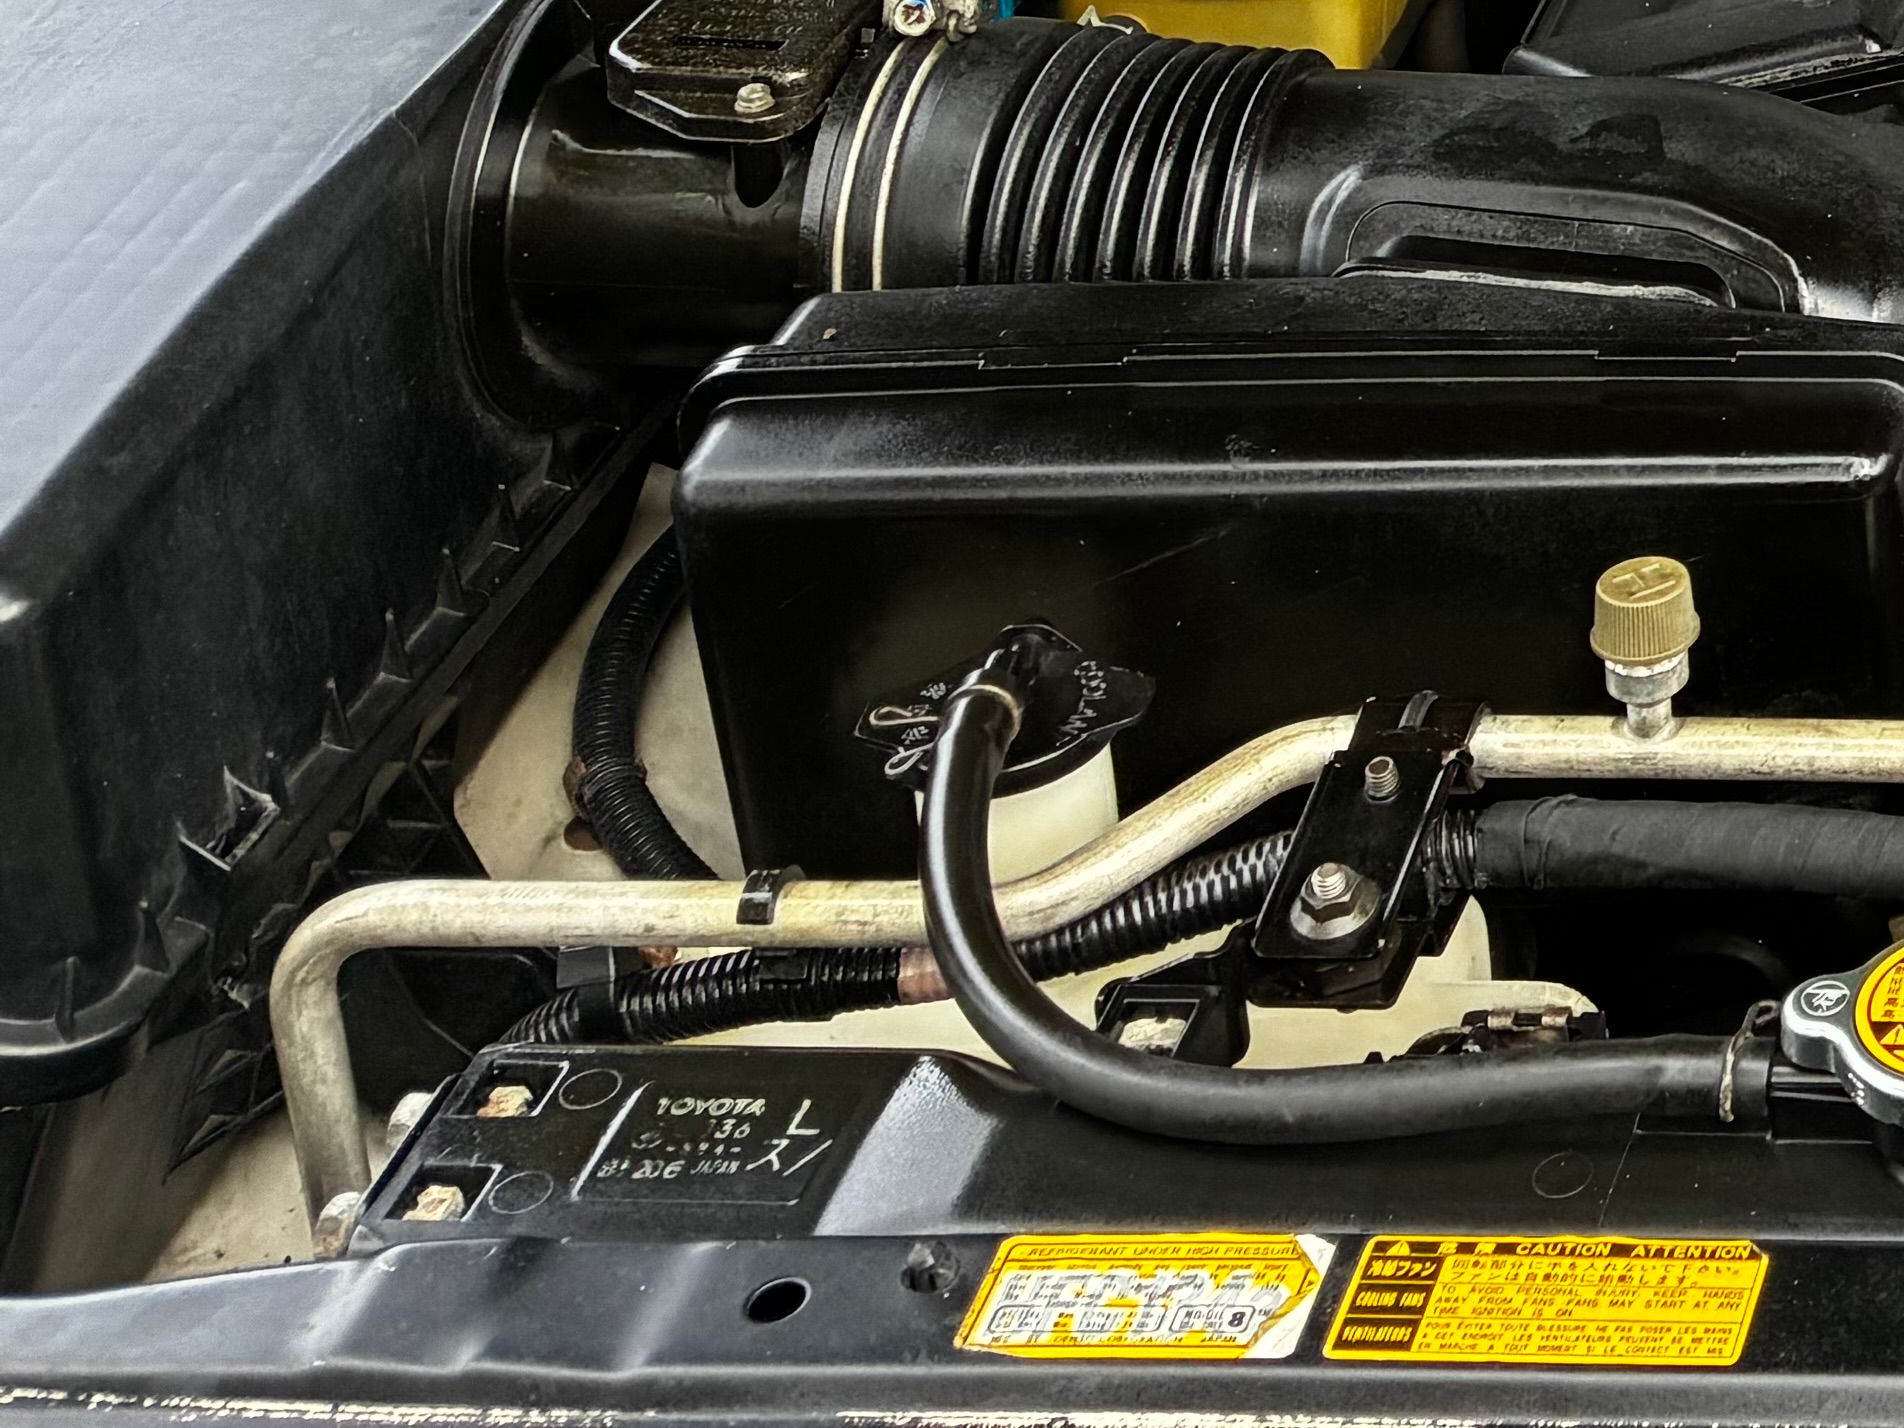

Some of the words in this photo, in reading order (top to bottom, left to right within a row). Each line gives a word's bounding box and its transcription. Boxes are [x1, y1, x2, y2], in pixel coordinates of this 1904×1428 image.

[1887, 987, 1900, 995] NE
[656, 1097, 766, 1117] TOYOTA
[786, 1098, 821, 1136] L
[689, 1159, 742, 1176] JAPAN
[1027, 1246, 1128, 1257] REFRIGERANT
[1132, 1246, 1181, 1257] UNDER
[1186, 1246, 1220, 1257] HIGH
[1515, 1242, 1613, 1257] CAUTION
[1630, 1243, 1752, 1259] ATTENTION
[1355, 1291, 1398, 1307] COOLING
[1399, 1291, 1427, 1307] FANS
[1440, 1285, 1456, 1294] TO
[1469, 1285, 1505, 1295] AVOID
[1517, 1286, 1580, 1297] PERSONAL
[1653, 1289, 1688, 1299] KEEP
[1702, 1289, 1745, 1300] HANDS
[1433, 1296, 1468, 1305] AWAY
[1478, 1297, 1513, 1306] FROM
[1566, 1298, 1599, 1308] FANS
[1607, 1298, 1634, 1308] MAY
[1644, 1299, 1686, 1309] START
[1693, 1300, 1707, 1309] AT
[1717, 1300, 1742, 1311] ANY
[1433, 1306, 1460, 1316] TIME
[1471, 1307, 1522, 1316] IGNITION
[1531, 1307, 1543, 1317] IS
[1556, 1308, 1574, 1318] ON
[1341, 1325, 1413, 1343] VENTILATEURS
[1425, 1322, 1451, 1330] POUR
[1499, 1322, 1530, 1331] TOUTE
[1535, 1323, 1587, 1333] BLESSURE
[1595, 1324, 1612, 1333] NE
[1639, 1325, 1672, 1334] POSER
[1677, 1326, 1697, 1335] LES
[1702, 1327, 1733, 1336] MAINS
[1434, 1332, 1454, 1340] CET
[1512, 1333, 1533, 1342] LES
[1539, 1334, 1612, 1344] VENTILATEURS
[1618, 1335, 1665, 1344] PEUVENT
[1690, 1336, 1729, 1345] METTRE
[1417, 1342, 1433, 1350] EN
[1438, 1343, 1477, 1351] MARCHE
[1503, 1343, 1529, 1352] TOUT
[1535, 1344, 1577, 1353] MOMENT
[1603, 1346, 1616, 1354] LE
[1624, 1346, 1670, 1354] CONTACT
[1678, 1347, 1698, 1355] EST
[1706, 1347, 1724, 1356] MIS
